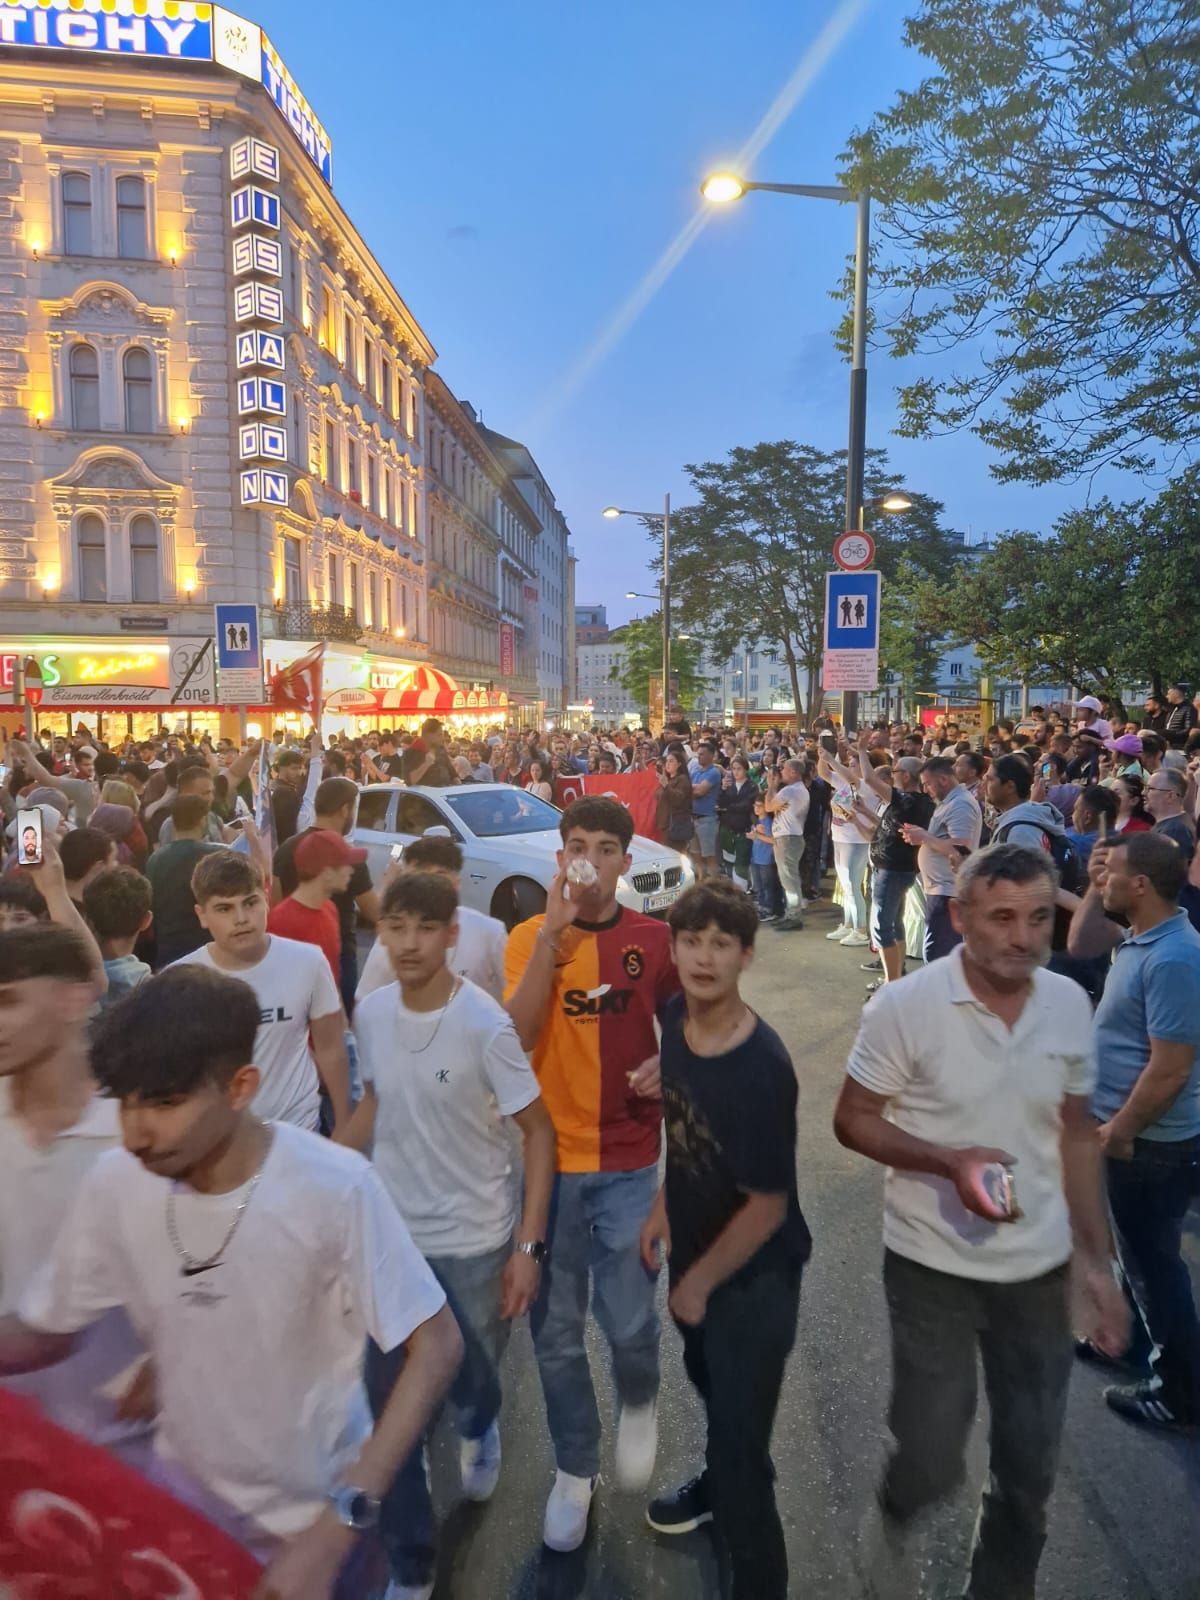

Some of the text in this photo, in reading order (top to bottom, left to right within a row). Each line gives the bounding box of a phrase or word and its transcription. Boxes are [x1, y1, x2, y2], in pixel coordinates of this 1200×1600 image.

[0, 7, 196, 56] TICHY
[266, 58, 328, 172] TICHY
[254, 141, 285, 501] EISSALON
[177, 651, 204, 675] 30
[51, 687, 157, 702] Eismarillenknödel
